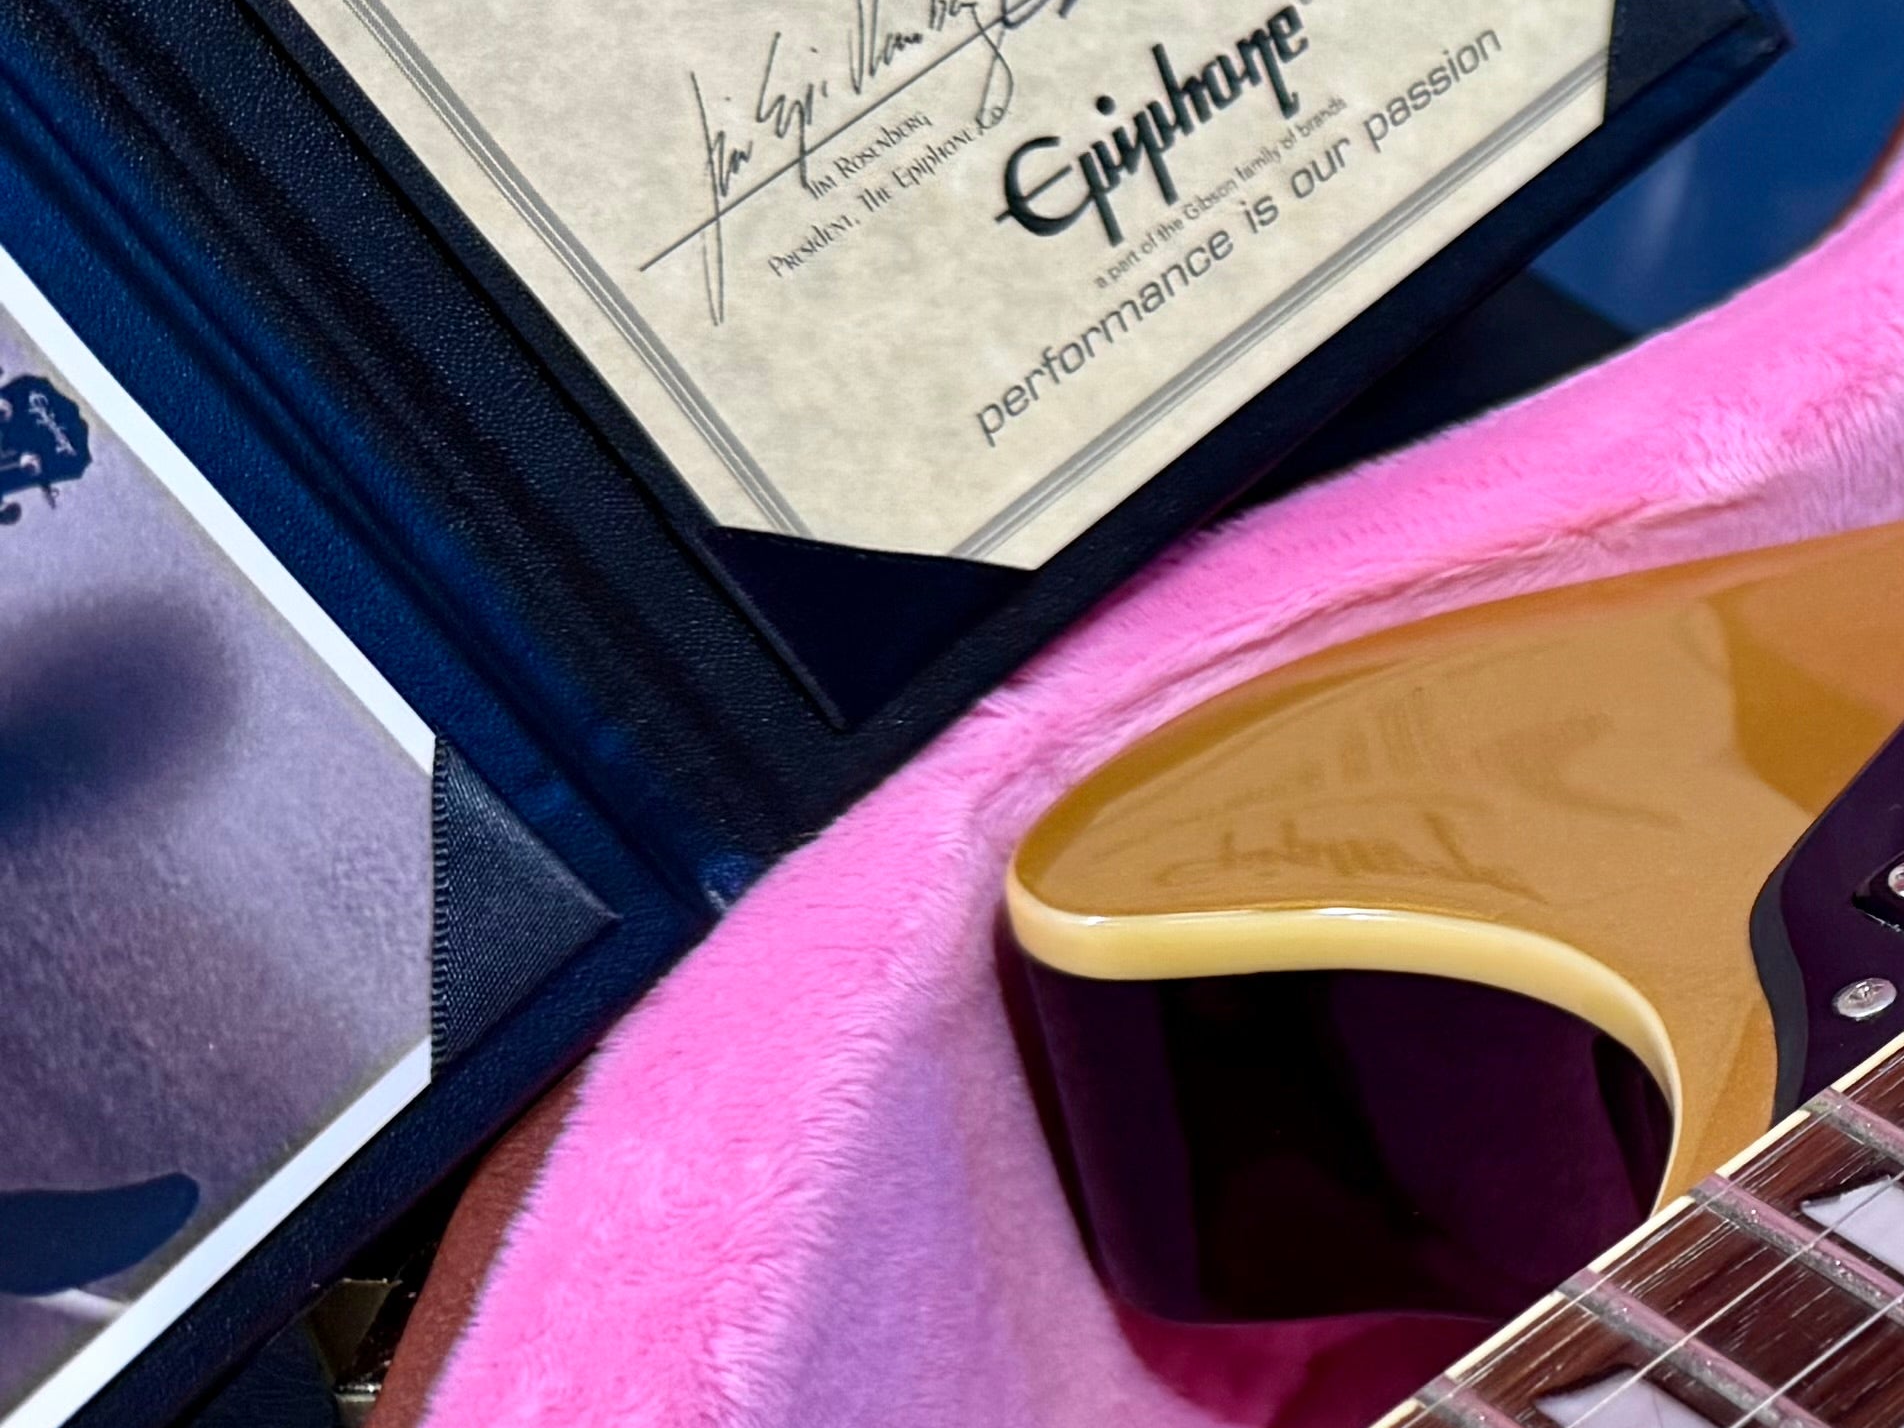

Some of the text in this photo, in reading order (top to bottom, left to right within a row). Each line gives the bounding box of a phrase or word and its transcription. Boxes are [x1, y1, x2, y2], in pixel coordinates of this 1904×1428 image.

[972, 27, 1503, 449] performance is our passion
[992, 6, 1309, 249] Epiphone
[1102, 248, 1143, 284] part
[1137, 228, 1160, 256] of
[1150, 216, 1186, 244] the
[1179, 177, 1240, 222] Gibson
[1232, 141, 1283, 183] family
[1275, 126, 1299, 152] of
[1292, 94, 1349, 139] brands
